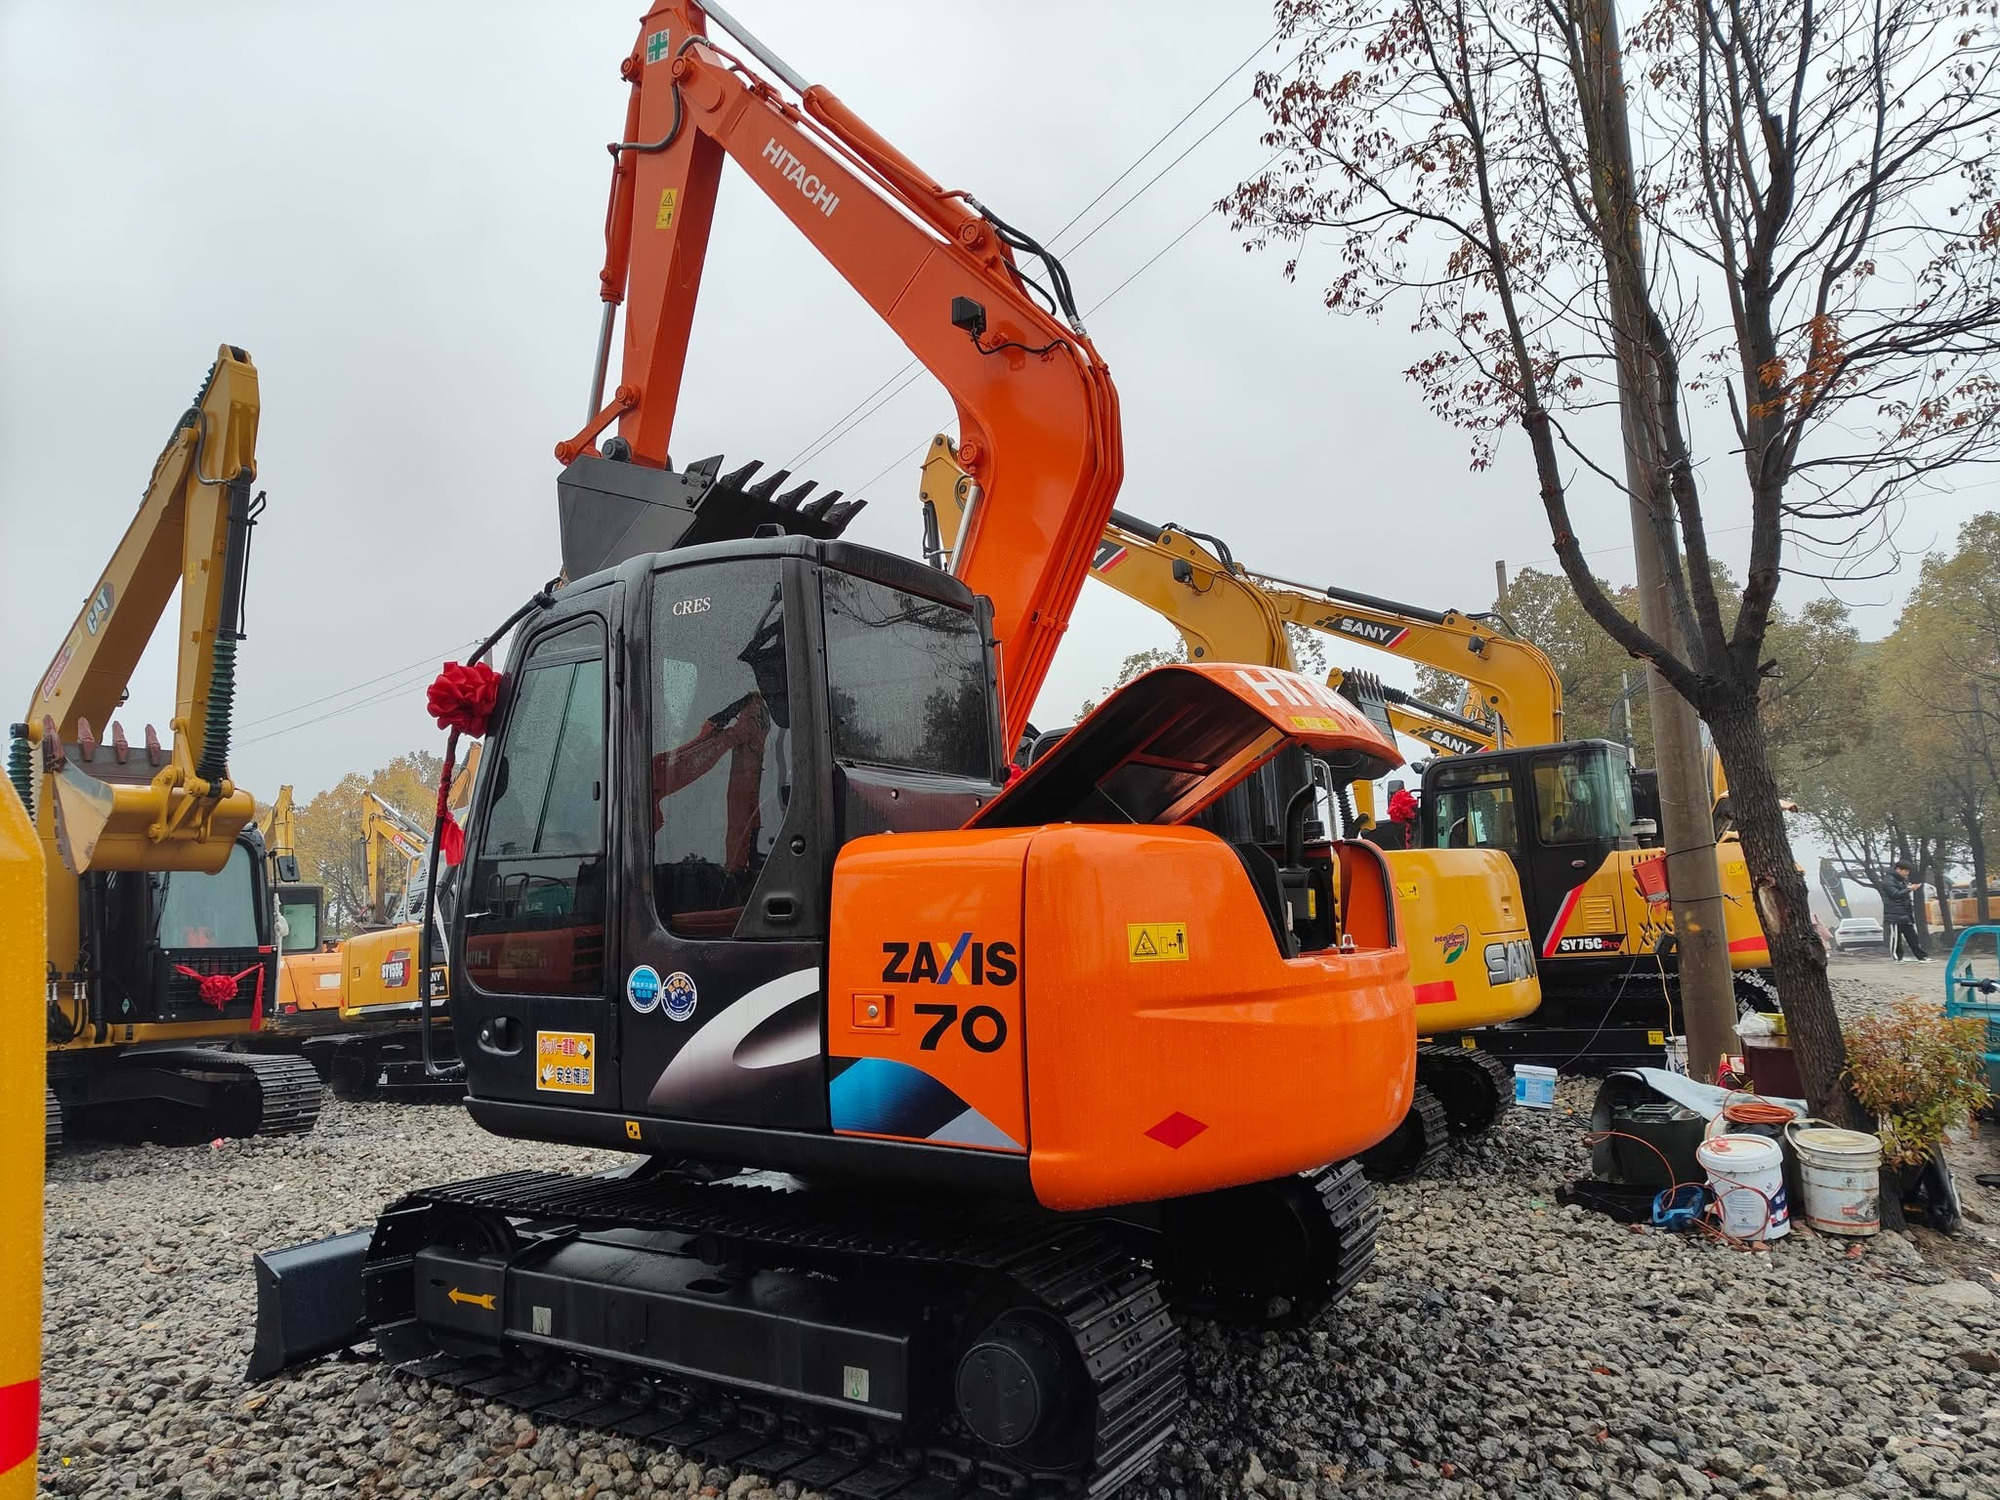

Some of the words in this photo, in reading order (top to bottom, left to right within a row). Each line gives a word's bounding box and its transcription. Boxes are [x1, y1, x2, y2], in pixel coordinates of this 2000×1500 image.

[762, 137, 840, 218] HITACHI
[86, 587, 109, 636] CAT
[672, 597, 711, 616] CRES
[1340, 618, 1391, 641] SANY
[1431, 731, 1473, 755] SANY
[882, 932, 1018, 986] ZAXIS
[1484, 939, 1536, 986] SAN
[1561, 937, 1603, 951] SY75C
[1602, 940, 1620, 949] Pro
[914, 1003, 1008, 1053] 70
